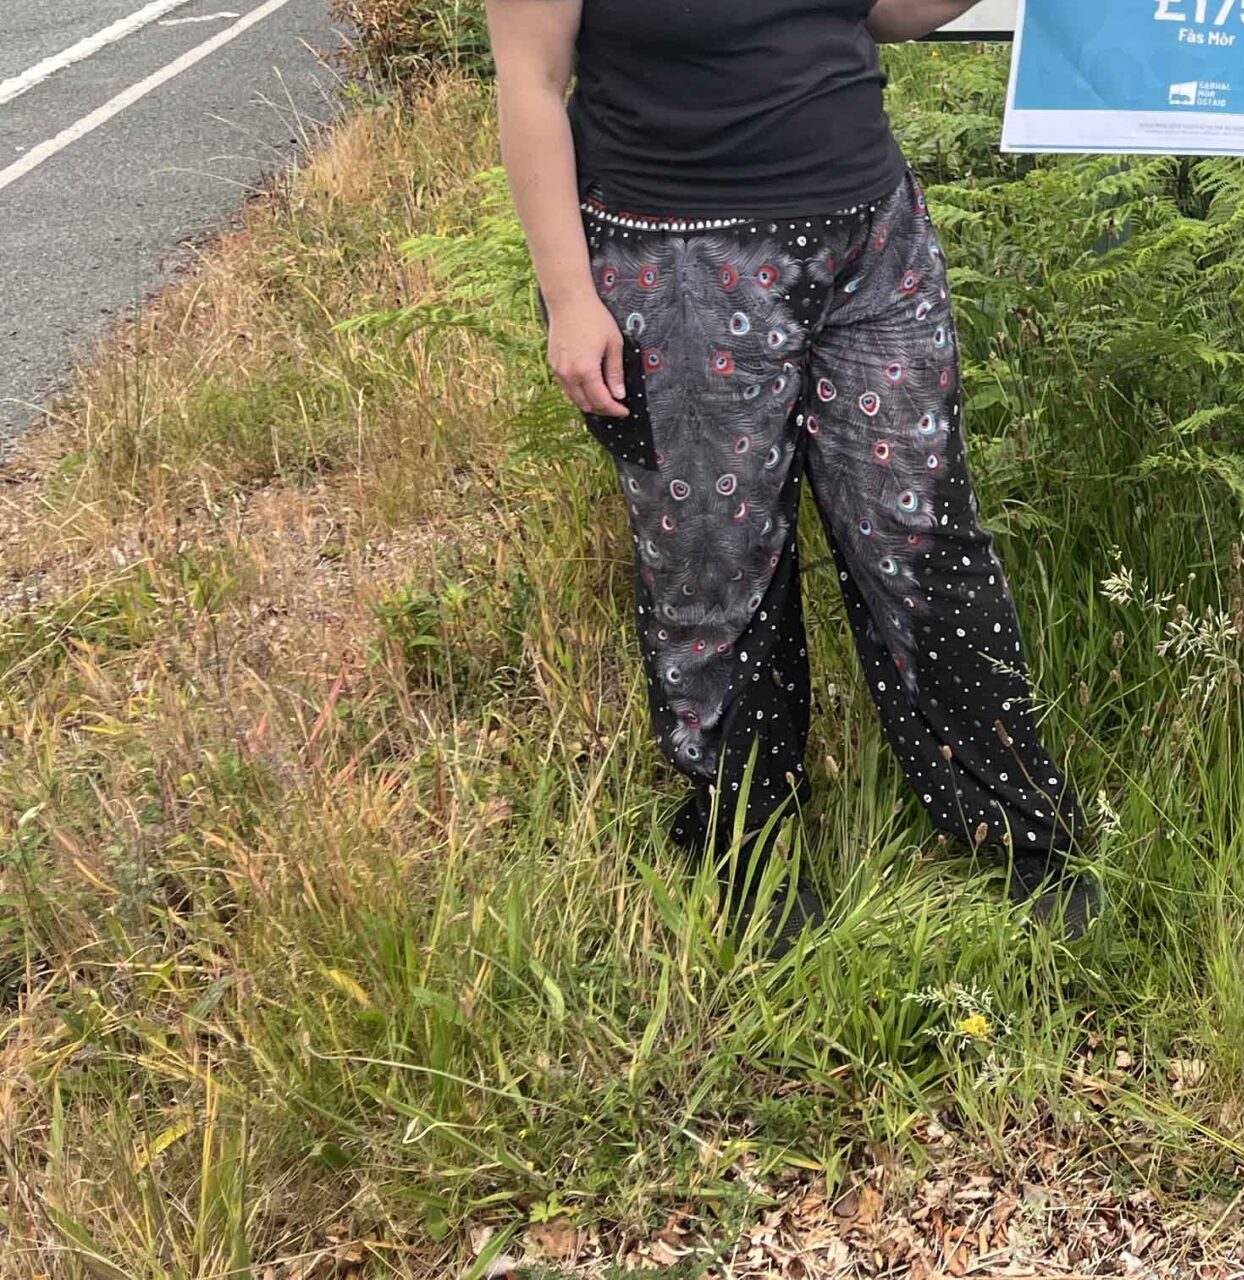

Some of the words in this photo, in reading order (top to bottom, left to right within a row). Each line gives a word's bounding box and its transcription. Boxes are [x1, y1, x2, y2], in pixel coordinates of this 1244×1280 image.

[1178, 28, 1205, 44] Fàs
[1208, 30, 1236, 47] Mòr
[1198, 80, 1232, 91] SABHAL
